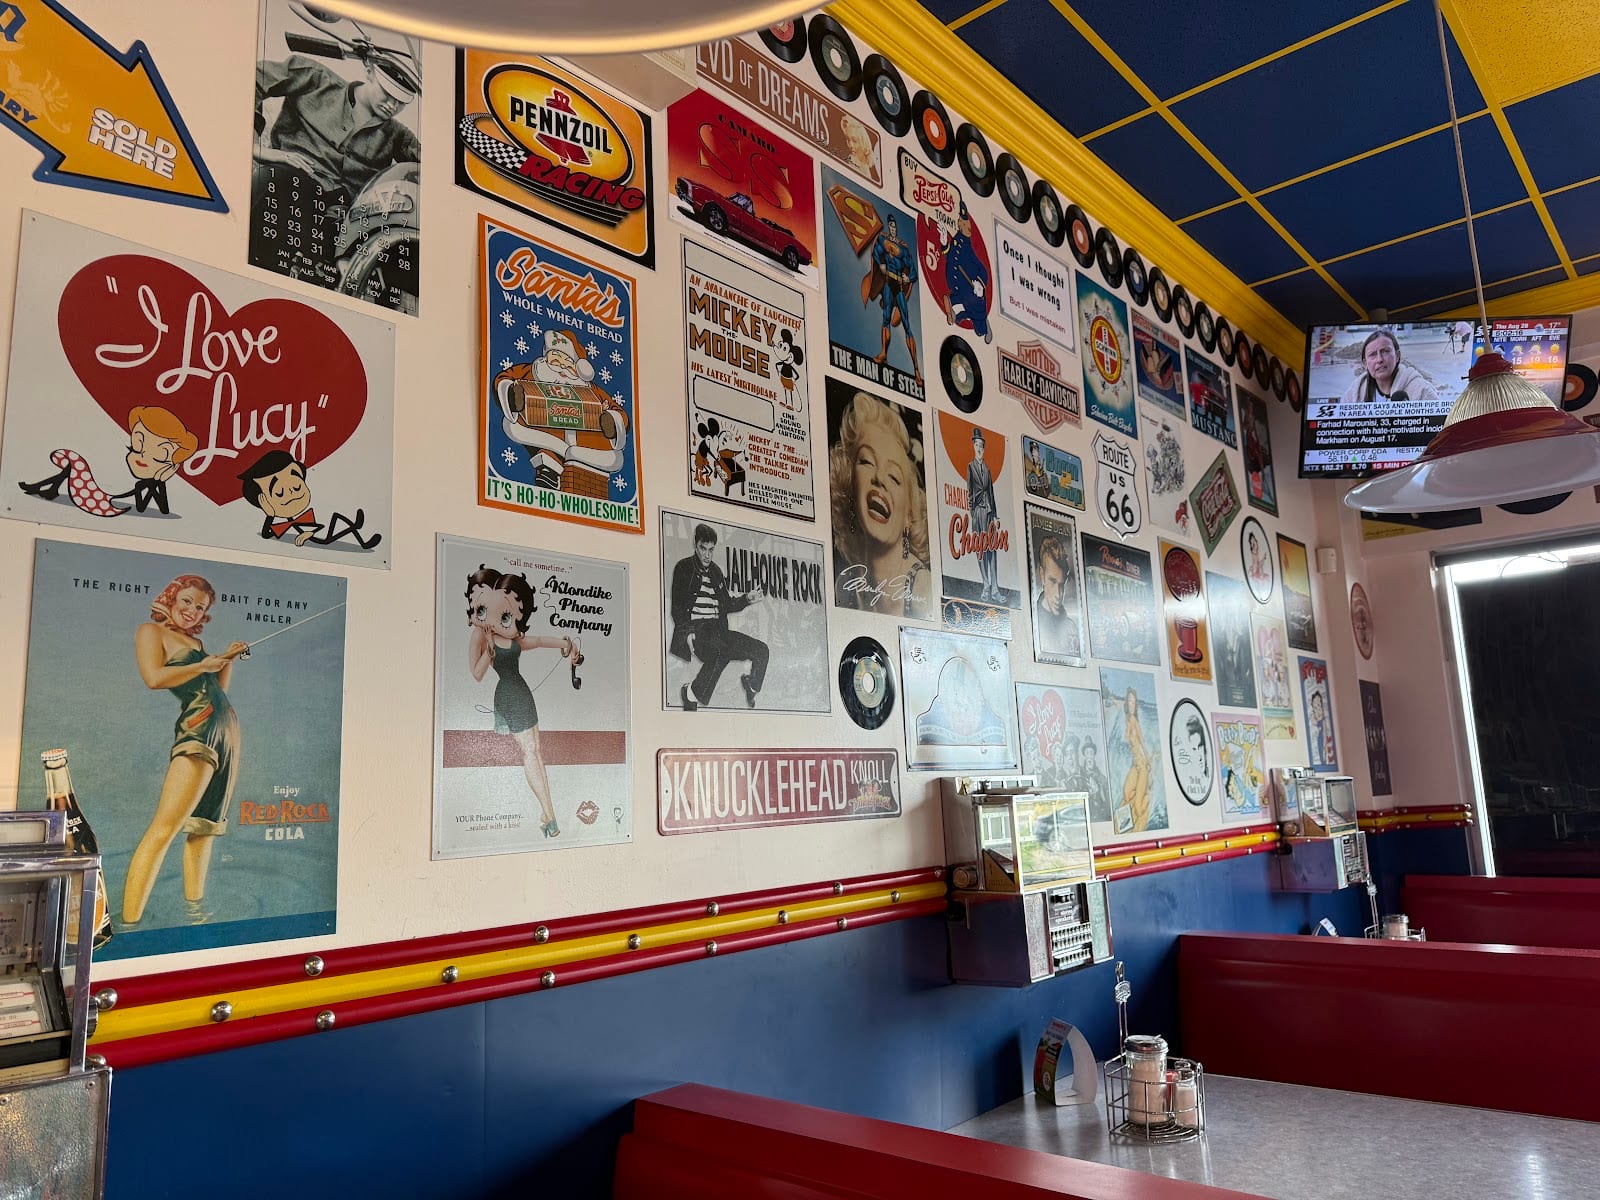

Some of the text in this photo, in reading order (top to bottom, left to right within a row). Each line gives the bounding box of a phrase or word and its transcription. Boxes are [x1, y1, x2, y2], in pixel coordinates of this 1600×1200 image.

[740, 59, 753, 88] OF
[758, 61, 829, 146] DREAMS
[92, 108, 178, 160] SOLD
[509, 96, 613, 154] PENNZOIL
[718, 114, 776, 153] CAMARO
[88, 125, 176, 180] HERE
[904, 156, 918, 172] BUY
[292, 176, 344, 204] 2 3 4
[518, 154, 646, 210] RACING
[268, 182, 325, 212] 8 9 10
[265, 196, 409, 256] 15 16 17 18 21
[263, 226, 323, 255] 29 30 31
[264, 211, 410, 271] 22 23 24 27 28
[1003, 240, 1064, 289] Once I thought
[496, 247, 625, 328] Santa's
[1012, 267, 1061, 311] I was wrong
[689, 287, 776, 346] MICKEY
[690, 274, 801, 331] AN AVALANCHE OF LAUGHTER
[1010, 296, 1021, 308] But
[1026, 307, 1038, 318] was
[1040, 314, 1066, 334] mistaken
[502, 290, 623, 344] WHOLE WHEAT BREAD
[156, 292, 280, 394] Love
[689, 323, 770, 379] MOUSE
[691, 361, 704, 373] HIS
[706, 366, 731, 384] LATEST
[832, 346, 925, 399] THE MAN OF STEEL
[1025, 348, 1056, 376] MOTOR
[1512, 357, 1522, 365] 15
[1004, 358, 1078, 413] HARLEY-DAVIDSON
[552, 416, 579, 424] BREAD
[1028, 398, 1059, 425] CYCLES
[1393, 418, 1421, 427] charged
[748, 434, 770, 446] MICKEY
[1192, 412, 1236, 448] MUSTANG
[1316, 428, 1355, 436] connection
[1372, 426, 1424, 434] hate-motivated
[1316, 436, 1348, 444] Markham
[1360, 435, 1385, 444] August
[748, 444, 808, 467] GREATEST COMEDIAN
[749, 453, 805, 475] THE TALKIES HAVE
[1103, 444, 1129, 469] ROUTE
[487, 478, 512, 500] IT'S
[1109, 472, 1125, 487] US
[944, 483, 971, 511] CHARLIE
[1106, 489, 1134, 527] 66
[949, 512, 1008, 560] Chaplin
[73, 577, 150, 594] THE RIGHT
[552, 579, 613, 600] Klondike
[724, 547, 822, 604] JAILHOUSE ROCK
[221, 592, 309, 611] BAIT FOR ANY
[559, 598, 604, 615] Phone
[246, 612, 292, 625] ANGLER
[550, 613, 612, 636] Company
[274, 786, 300, 798] Enjoy
[673, 759, 888, 820] KNUCKLEHEAD KNOLL
[240, 800, 331, 825] RED ROCK
[456, 814, 475, 822] YOUR
[265, 827, 304, 840] COLA
